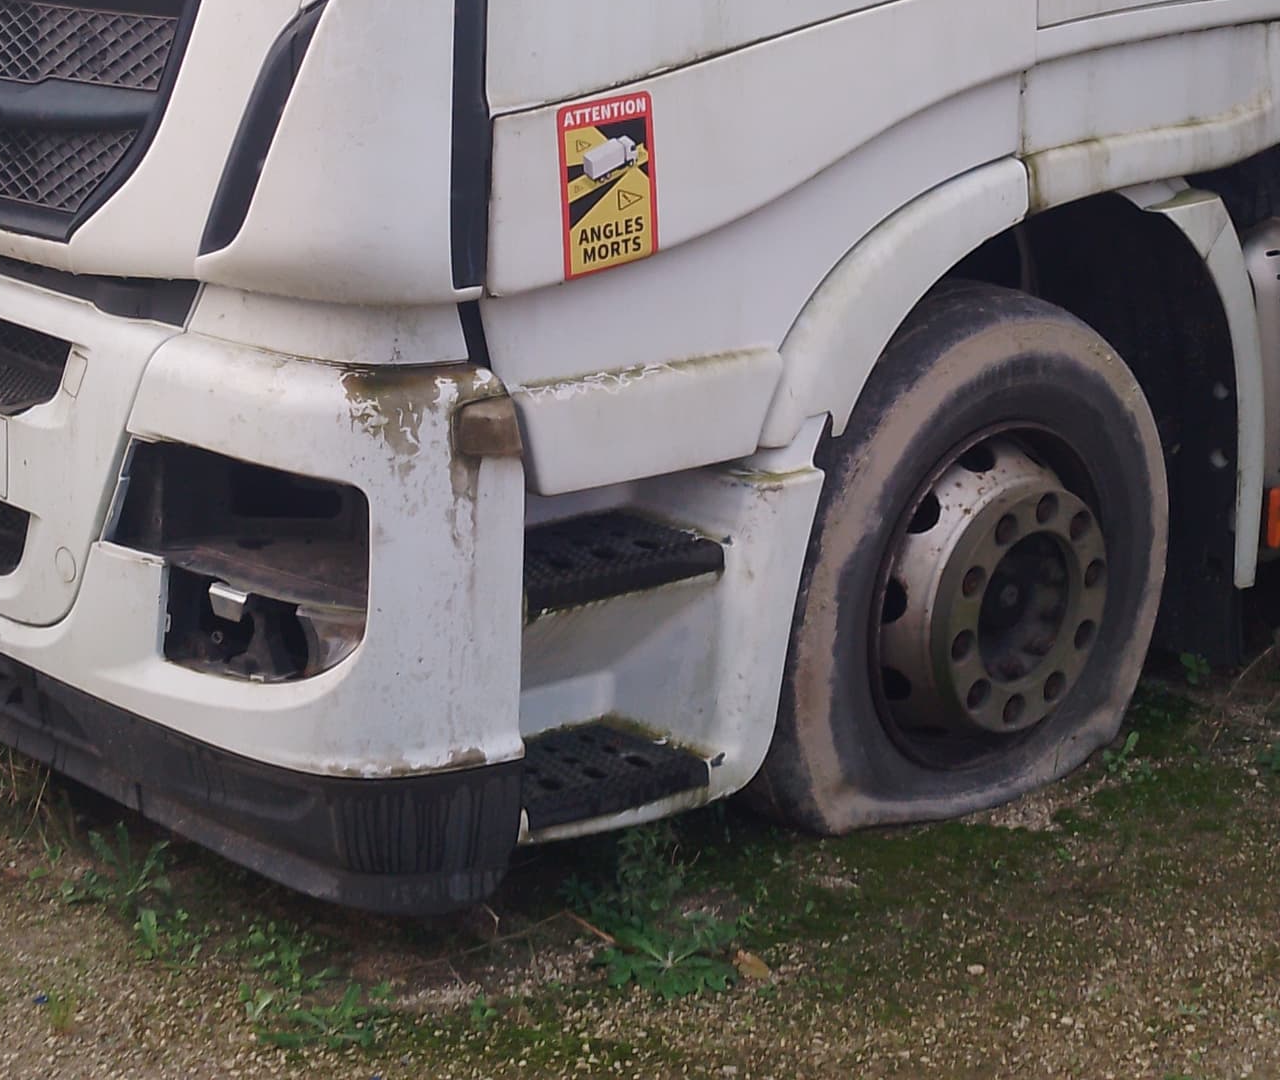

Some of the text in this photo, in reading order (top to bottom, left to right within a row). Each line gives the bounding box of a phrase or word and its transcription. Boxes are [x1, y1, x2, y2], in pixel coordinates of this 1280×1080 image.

[564, 97, 646, 128] ATTENTION
[579, 216, 644, 246] ANGLES
[583, 236, 641, 265] MORTS
